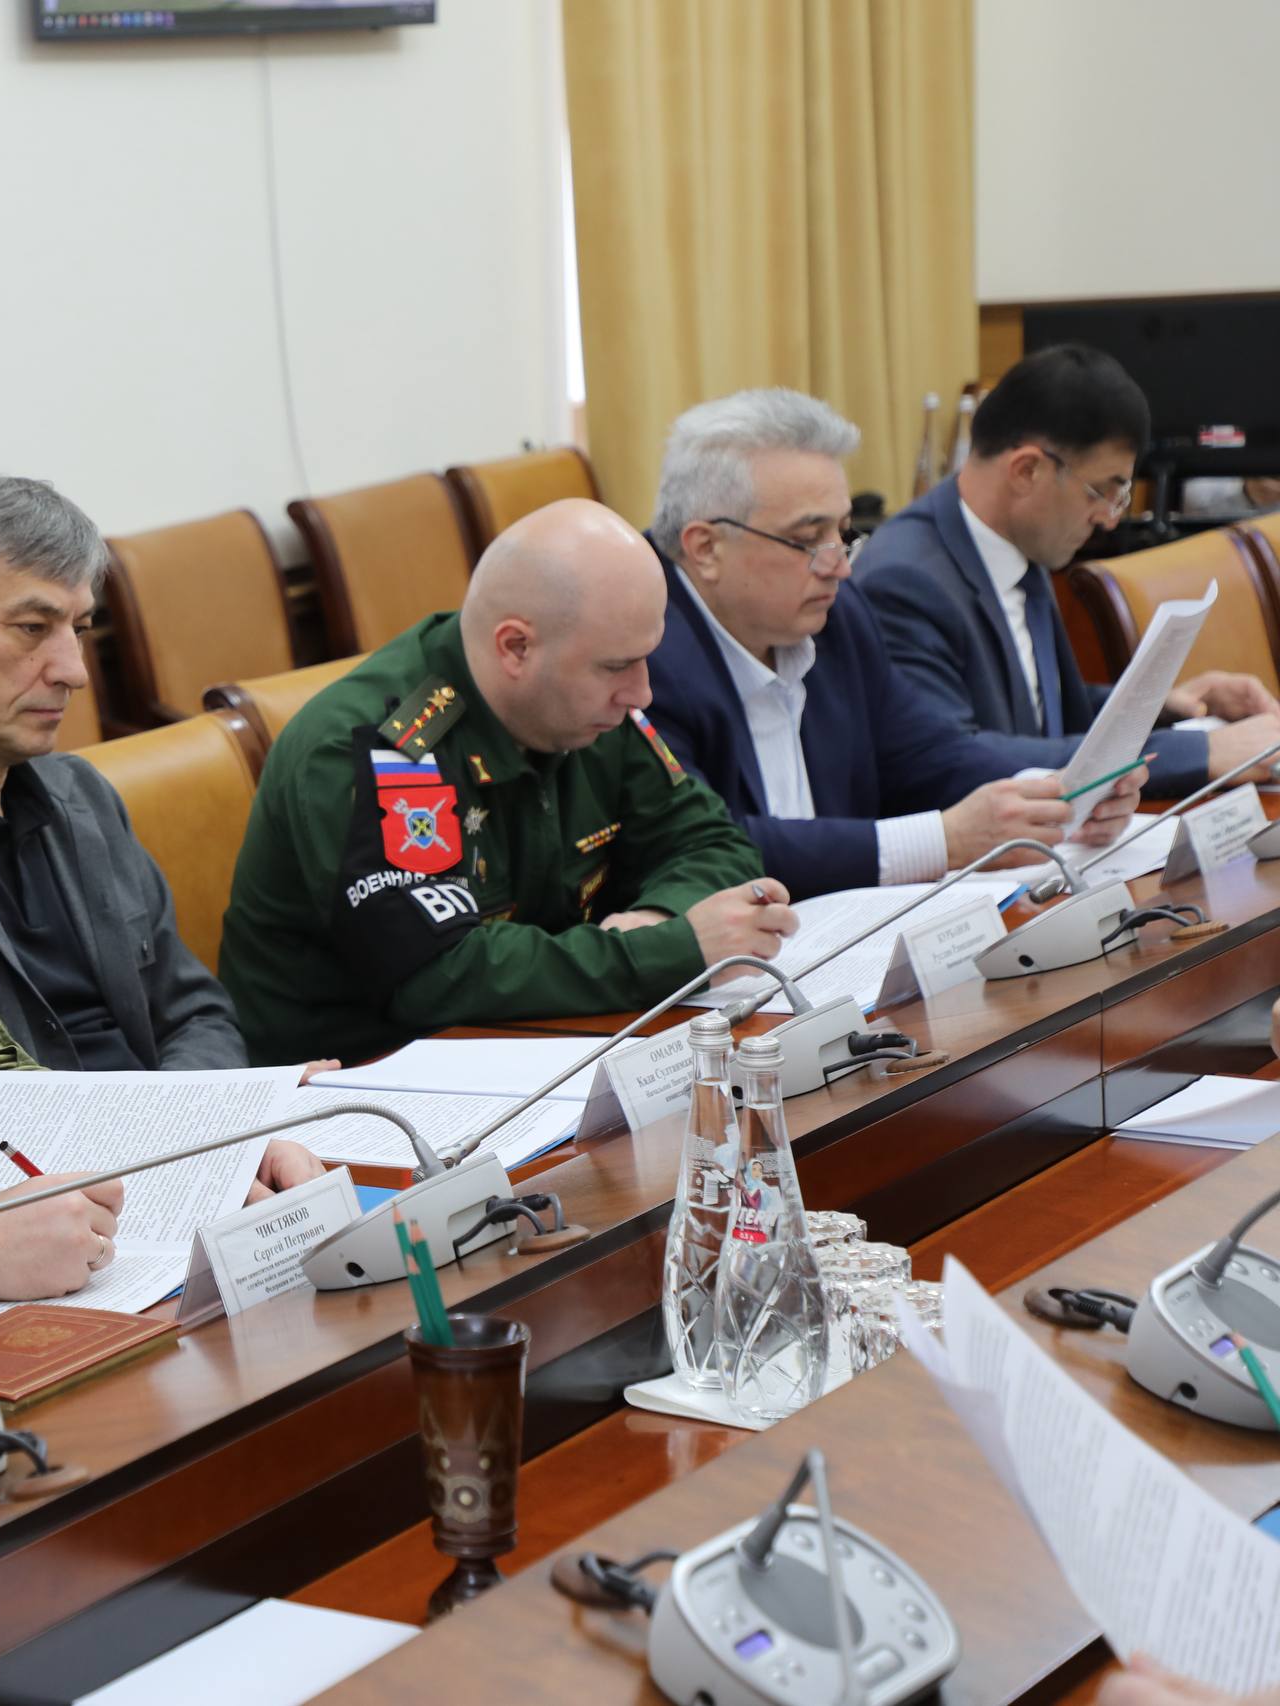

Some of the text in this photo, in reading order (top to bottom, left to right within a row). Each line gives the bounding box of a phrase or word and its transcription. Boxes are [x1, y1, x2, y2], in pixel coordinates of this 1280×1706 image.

[410, 883, 479, 923] ВП
[650, 1040, 684, 1062] ОМАРОВ
[255, 1206, 310, 1239] ЧИСТЯКОВ
[253, 1223, 326, 1263] Сергей Петрович
